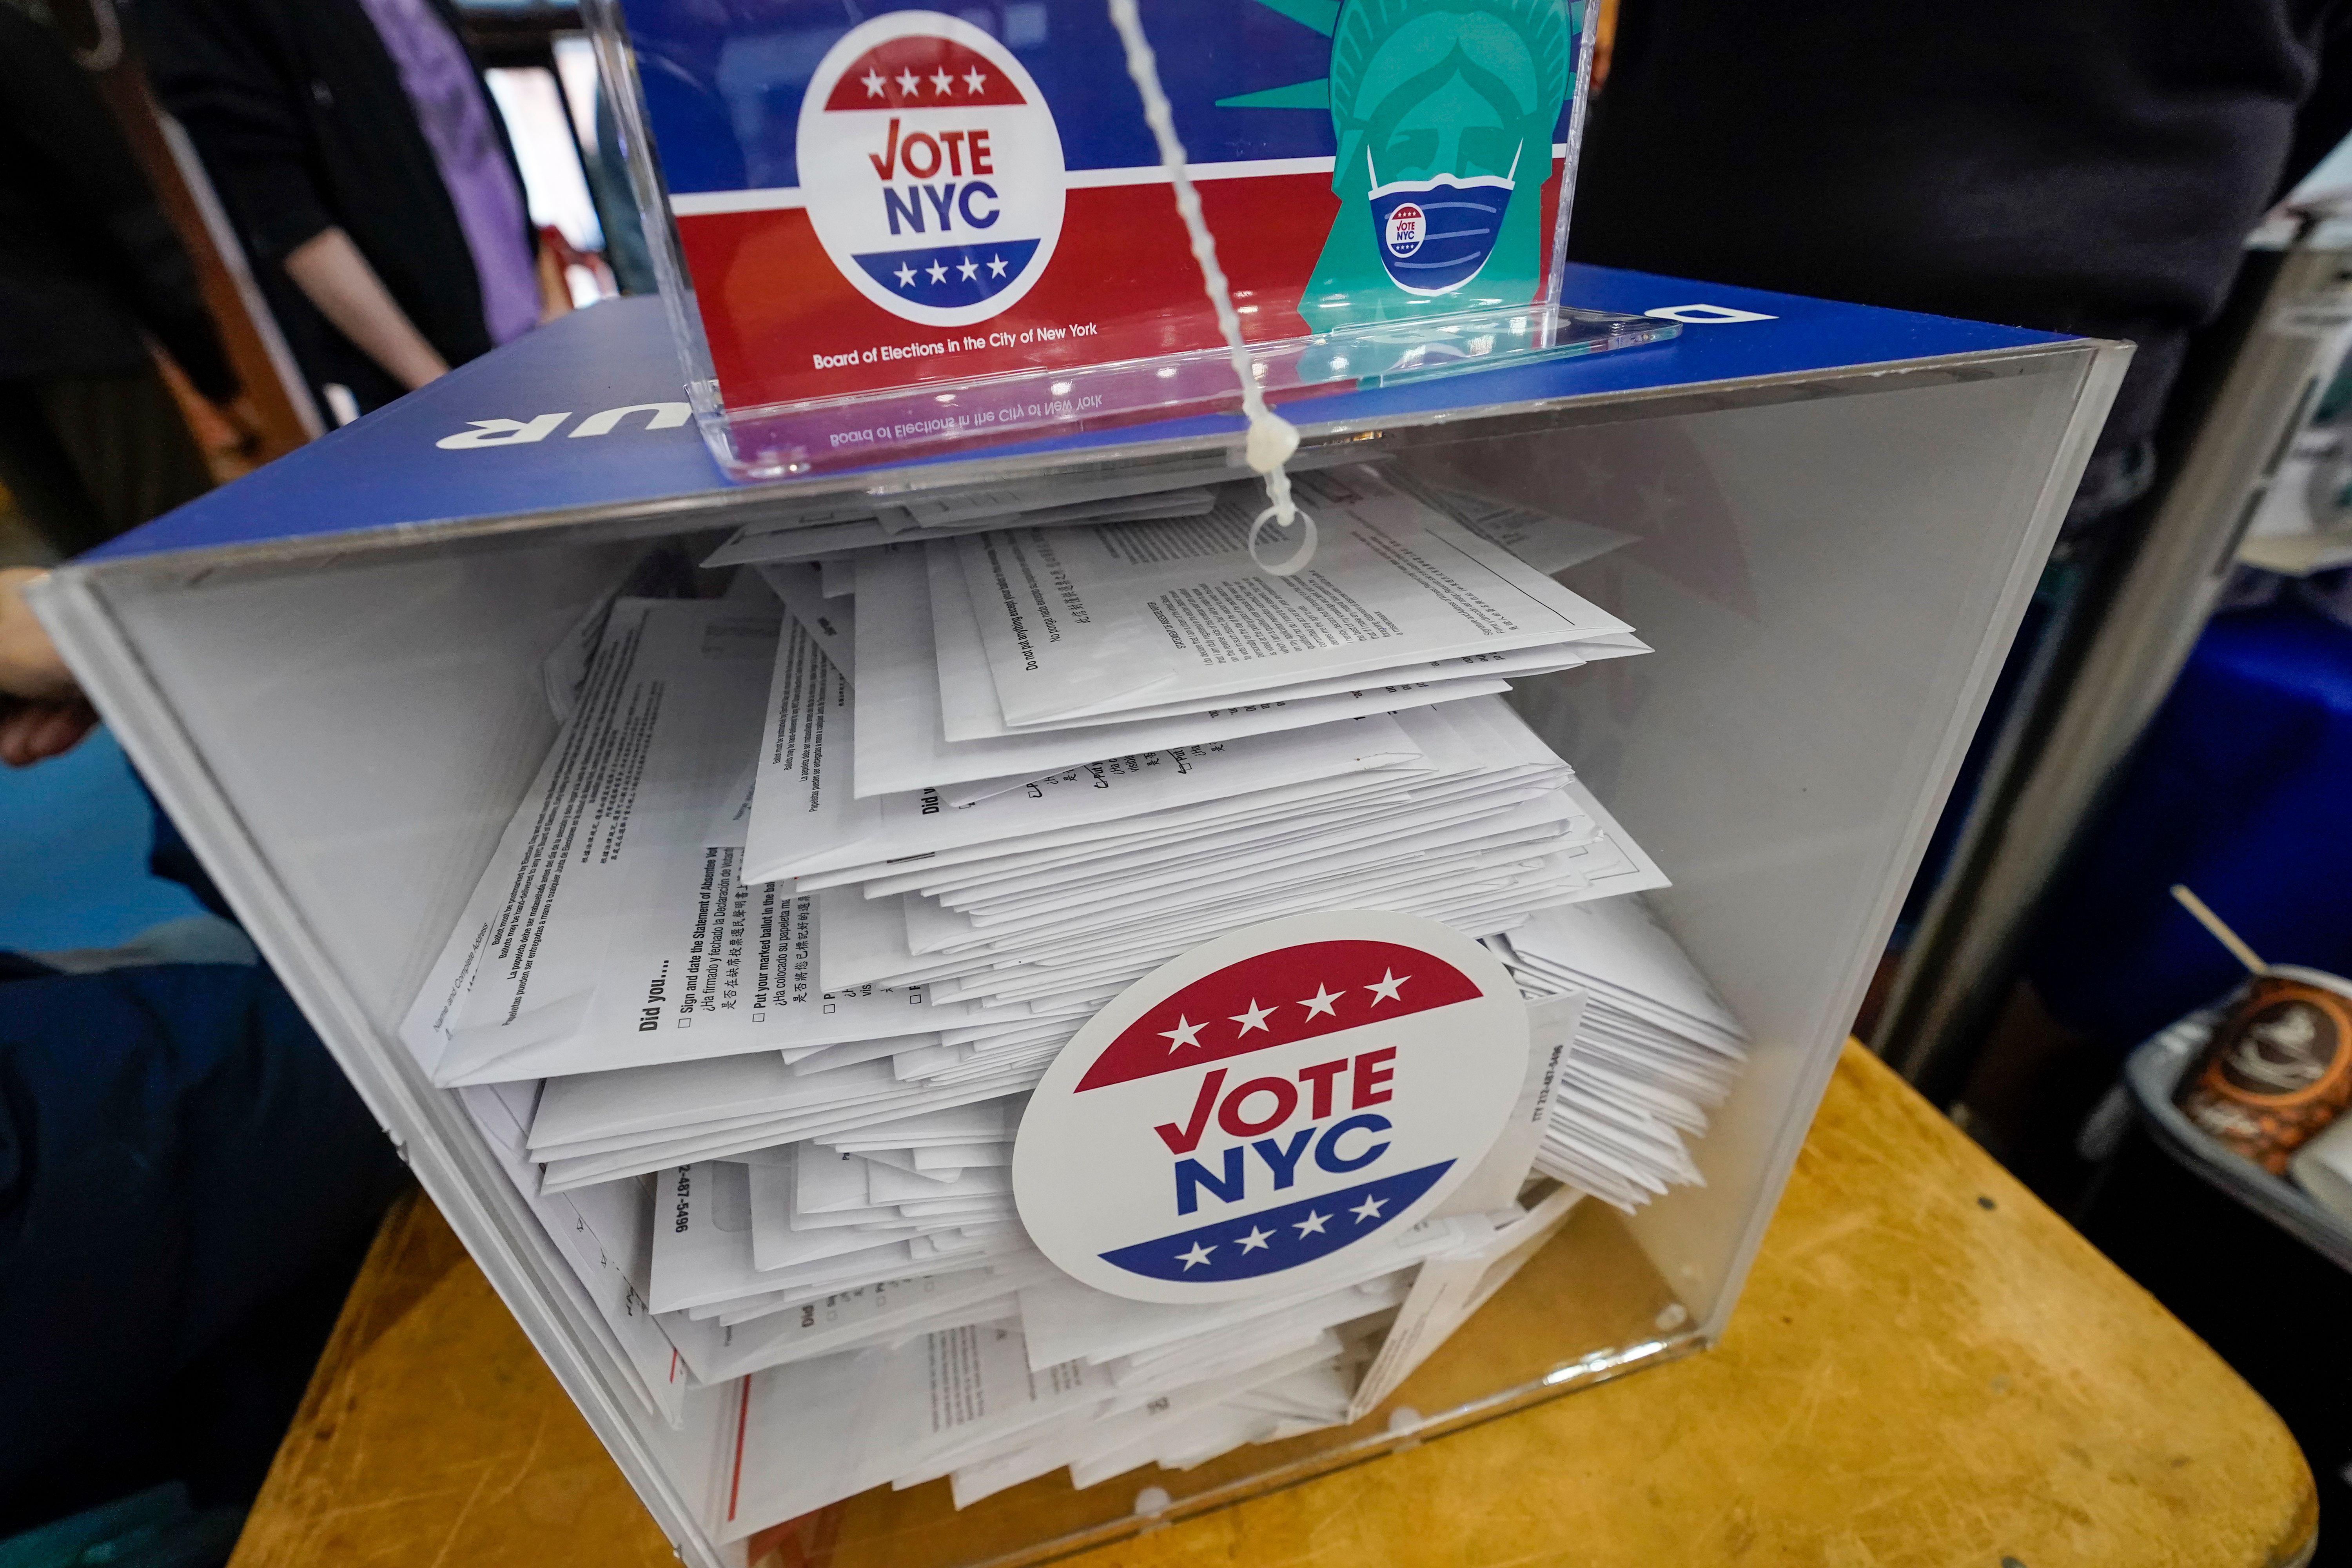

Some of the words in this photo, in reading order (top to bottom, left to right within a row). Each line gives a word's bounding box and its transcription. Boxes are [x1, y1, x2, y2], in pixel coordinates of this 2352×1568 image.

[868, 119, 993, 180] VOTE
[883, 181, 1001, 236] NYC
[1397, 220, 1415, 231] VOTE
[1397, 231, 1414, 241] NYC
[813, 353, 859, 370] Board
[863, 348, 877, 362] of
[881, 342, 944, 360] Elections
[947, 339, 960, 352] in
[963, 336, 986, 350] the
[989, 332, 1015, 351] City
[1020, 328, 1034, 343] of
[1037, 326, 1066, 341] New
[1069, 322, 1098, 337] York
[1005, 601, 1018, 617] except
[1038, 606, 1050, 618] nada
[1011, 616, 1027, 640] anything
[1044, 618, 1059, 633] ponga
[1018, 640, 1033, 650] put
[1022, 650, 1034, 660] not
[809, 790, 818, 812] Papeletas
[921, 797, 940, 815] Did
[548, 875, 560, 898] cualquier
[701, 860, 715, 890] Absentee
[714, 878, 729, 916] Declaración
[763, 894, 774, 906] the
[492, 927, 505, 946] Ballot
[500, 912, 510, 927] must
[509, 873, 524, 903] postmarked
[499, 938, 512, 959] Ballots
[507, 924, 519, 937] may
[515, 875, 534, 915] hand-delivered
[512, 944, 526, 970] papeleta
[520, 928, 531, 943] debe
[530, 884, 546, 916] matasellada
[541, 869, 551, 883] antes
[541, 904, 551, 920] mano
[693, 901, 709, 938] Statement
[760, 916, 772, 938] ballot
[779, 911, 790, 941] papeleta
[528, 926, 544, 958] entregadas
[691, 941, 703, 953] the
[709, 927, 723, 955] fechado
[447, 987, 456, 1006] and
[454, 952, 474, 988] Complete
[472, 922, 488, 953] Address
[524, 960, 533, 970] ser
[688, 955, 701, 973] date
[759, 940, 770, 970] marked
[648, 960, 668, 1003] you....
[703, 964, 718, 993] firmado
[758, 973, 769, 991] your
[775, 954, 787, 988] colocado
[517, 971, 529, 995] pueden
[686, 975, 698, 991] and
[680, 993, 697, 1013] Sign
[701, 996, 715, 1011] ¿Ha
[754, 993, 766, 1008] Put
[773, 990, 787, 1006] ¿Ha
[639, 1007, 660, 1031] Did
[1154, 1046, 1397, 1155] VOTE
[1175, 1113, 1393, 1216] NYC
